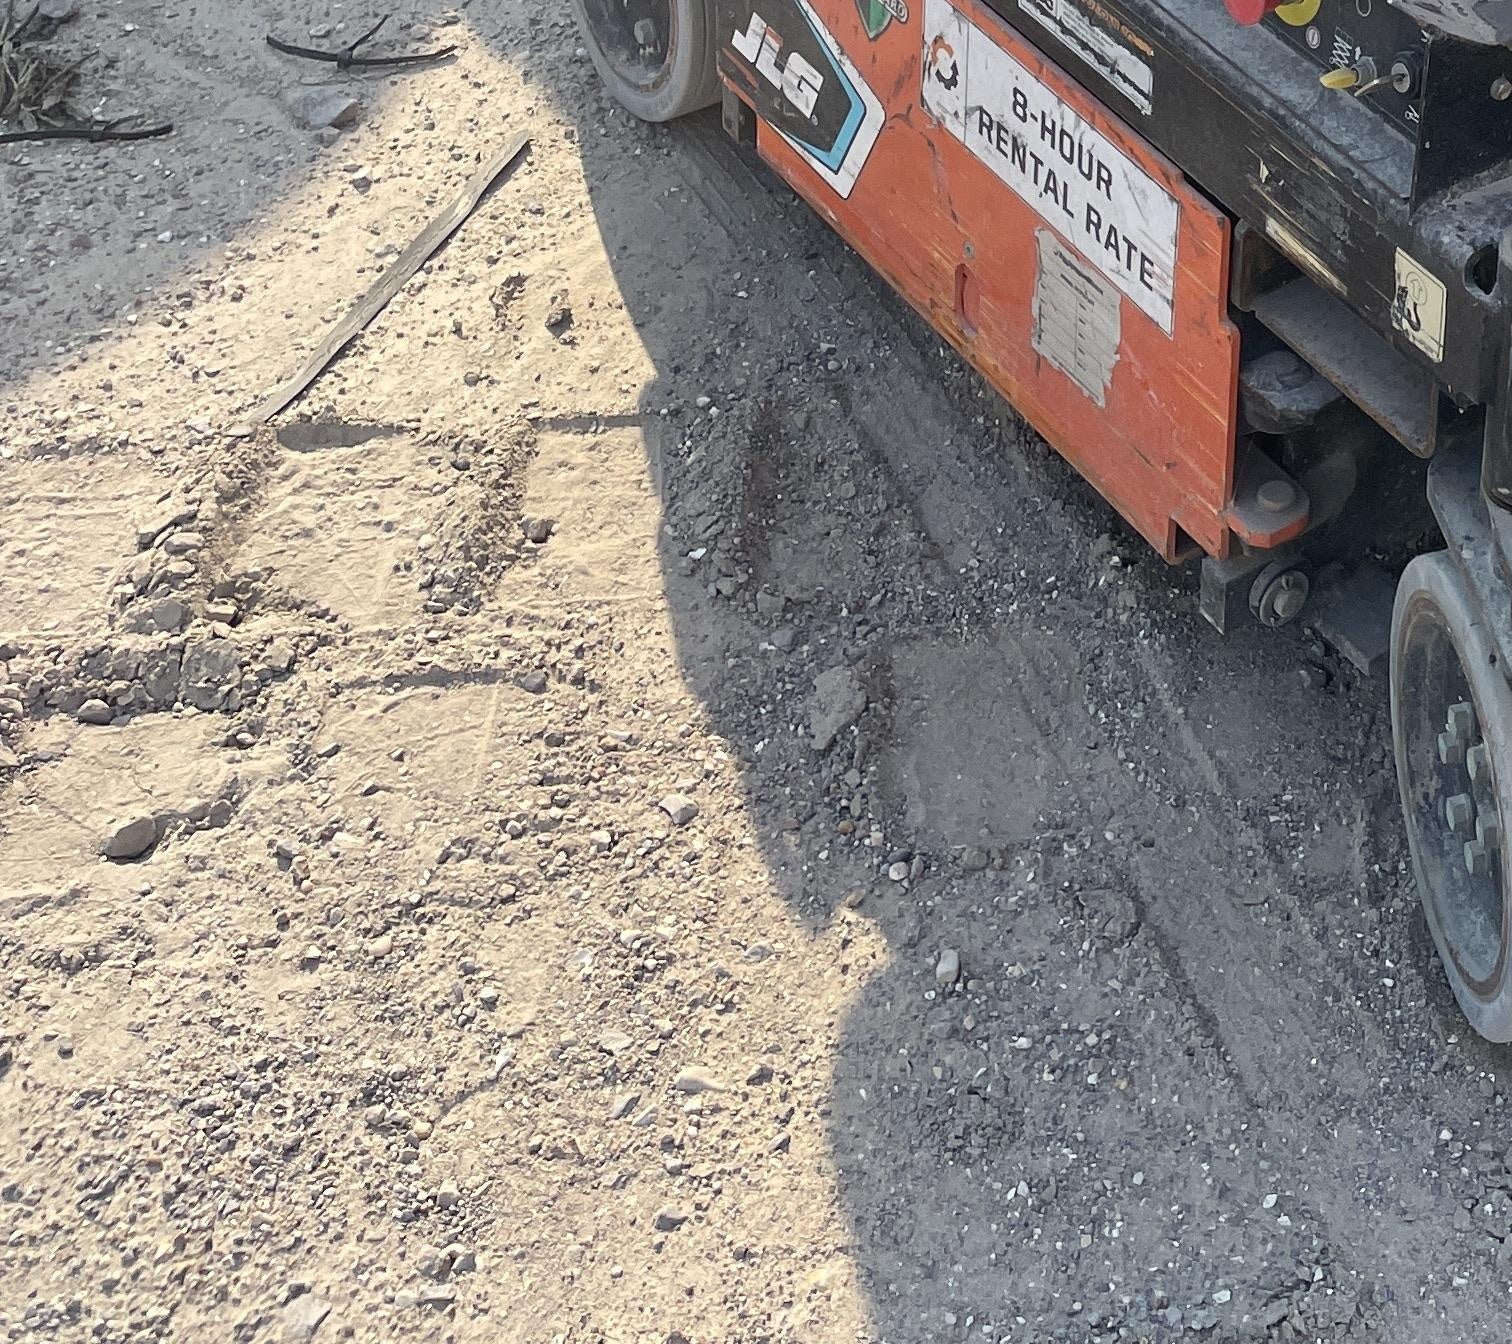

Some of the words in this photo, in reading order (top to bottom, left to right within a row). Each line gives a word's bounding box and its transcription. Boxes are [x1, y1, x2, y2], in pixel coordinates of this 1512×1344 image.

[731, 11, 825, 119] JLG
[978, 105, 1075, 219] RENTAL
[1086, 202, 1155, 292] RATE
[1012, 86, 1113, 202] 8-HOUR
